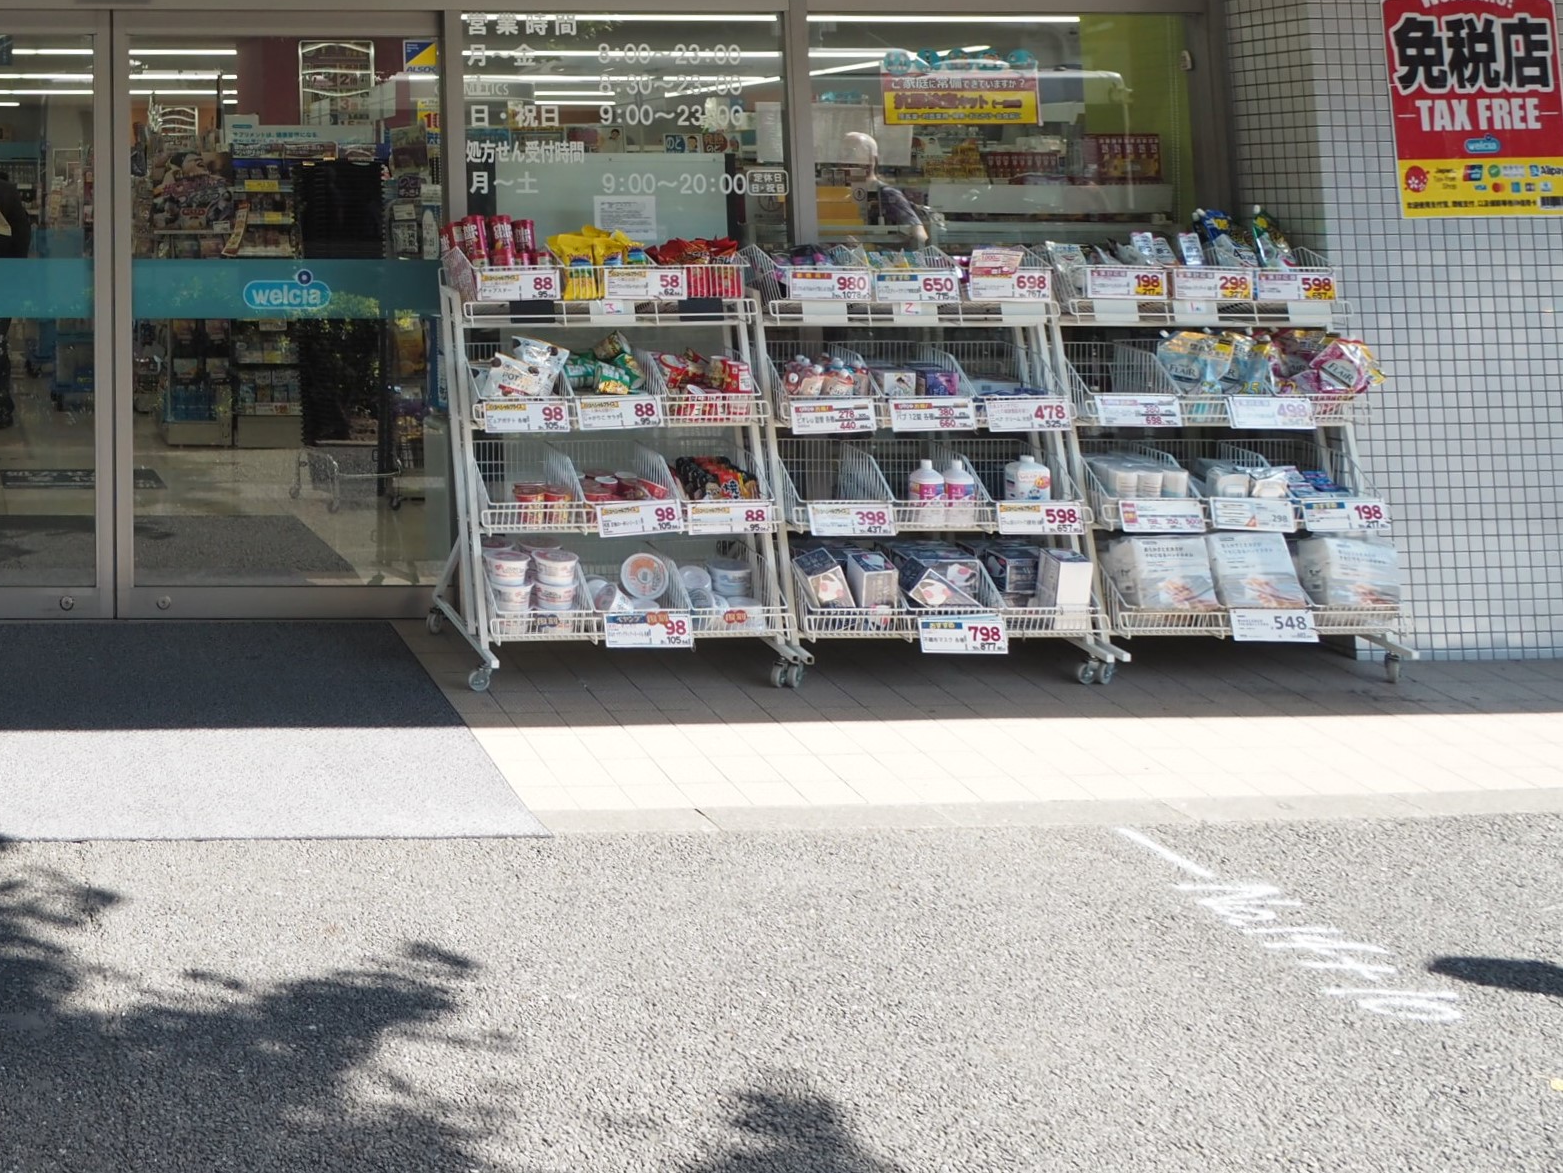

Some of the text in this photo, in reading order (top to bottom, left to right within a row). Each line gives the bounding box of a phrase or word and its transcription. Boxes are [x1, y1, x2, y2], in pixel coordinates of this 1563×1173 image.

[466, 13, 578, 36] 営業時間
[1392, 16, 1552, 91] 免税店
[1415, 96, 1542, 132] TAX FREE
[465, 140, 586, 164] 処方せん受付時間
[753, 172, 783, 183] 定休日
[533, 277, 553, 291] 88
[659, 274, 680, 288] 58
[837, 276, 867, 291] 980
[923, 277, 954, 292] 650
[1016, 275, 1047, 290] 698
[1136, 274, 1160, 288] 198
[1219, 276, 1248, 290] 298
[1301, 277, 1333, 292] 598
[249, 277, 322, 306] welcia
[538, 291, 549, 299] 95
[663, 288, 675, 296] 62
[542, 406, 564, 422] 98
[634, 403, 656, 418] 88
[838, 410, 855, 419] 278
[939, 407, 955, 417] 380
[1034, 404, 1066, 420] 478
[1277, 403, 1308, 418] 498
[544, 421, 559, 430] 105
[839, 421, 856, 430] 440
[939, 419, 956, 428] 660
[1045, 420, 1061, 428] 525
[655, 506, 676, 522] 98
[745, 509, 766, 522] 88
[855, 511, 887, 526] 398
[1045, 508, 1078, 524] 598
[1272, 514, 1288, 523] 298
[1354, 504, 1383, 520] 198
[658, 522, 672, 530] 105
[665, 619, 686, 636] 98
[1273, 615, 1308, 631] 548
[667, 636, 682, 644] 105
[967, 625, 1002, 642] 798
